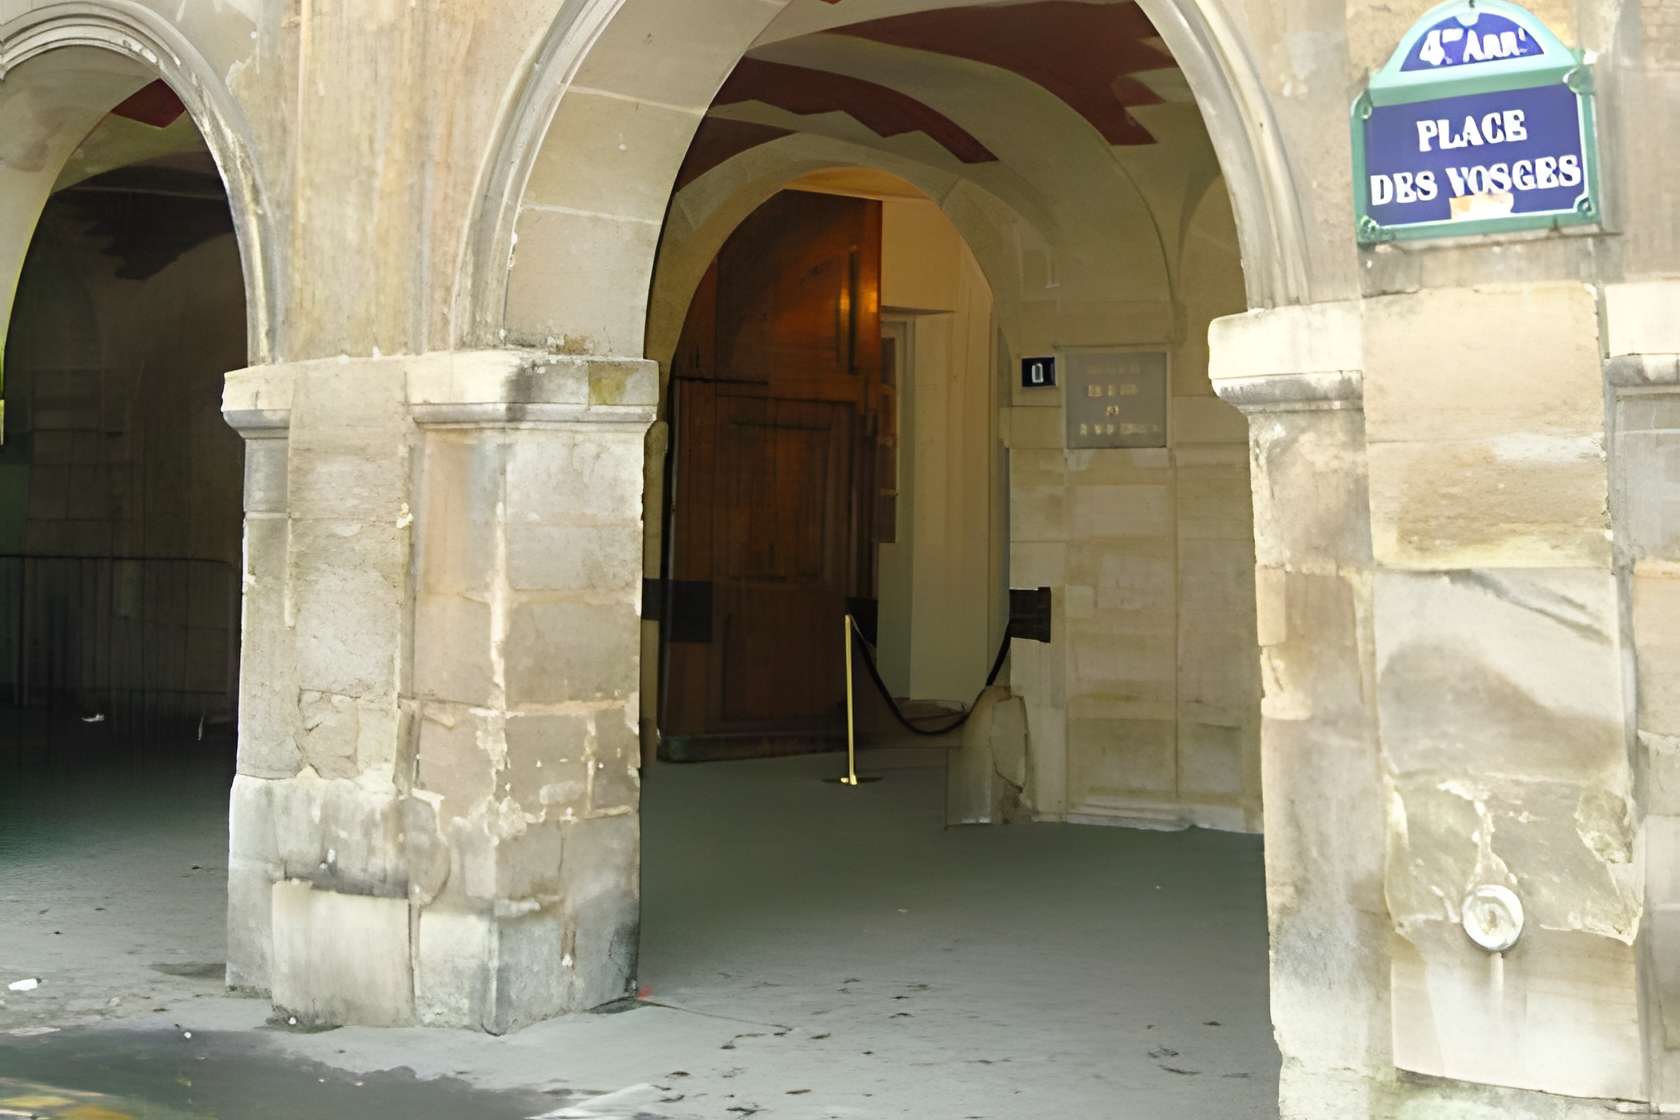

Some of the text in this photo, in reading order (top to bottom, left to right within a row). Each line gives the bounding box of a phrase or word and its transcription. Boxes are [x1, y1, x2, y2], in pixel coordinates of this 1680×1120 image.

[1416, 109, 1528, 152] PLACE
[1370, 154, 1581, 206] DES VOSGES
